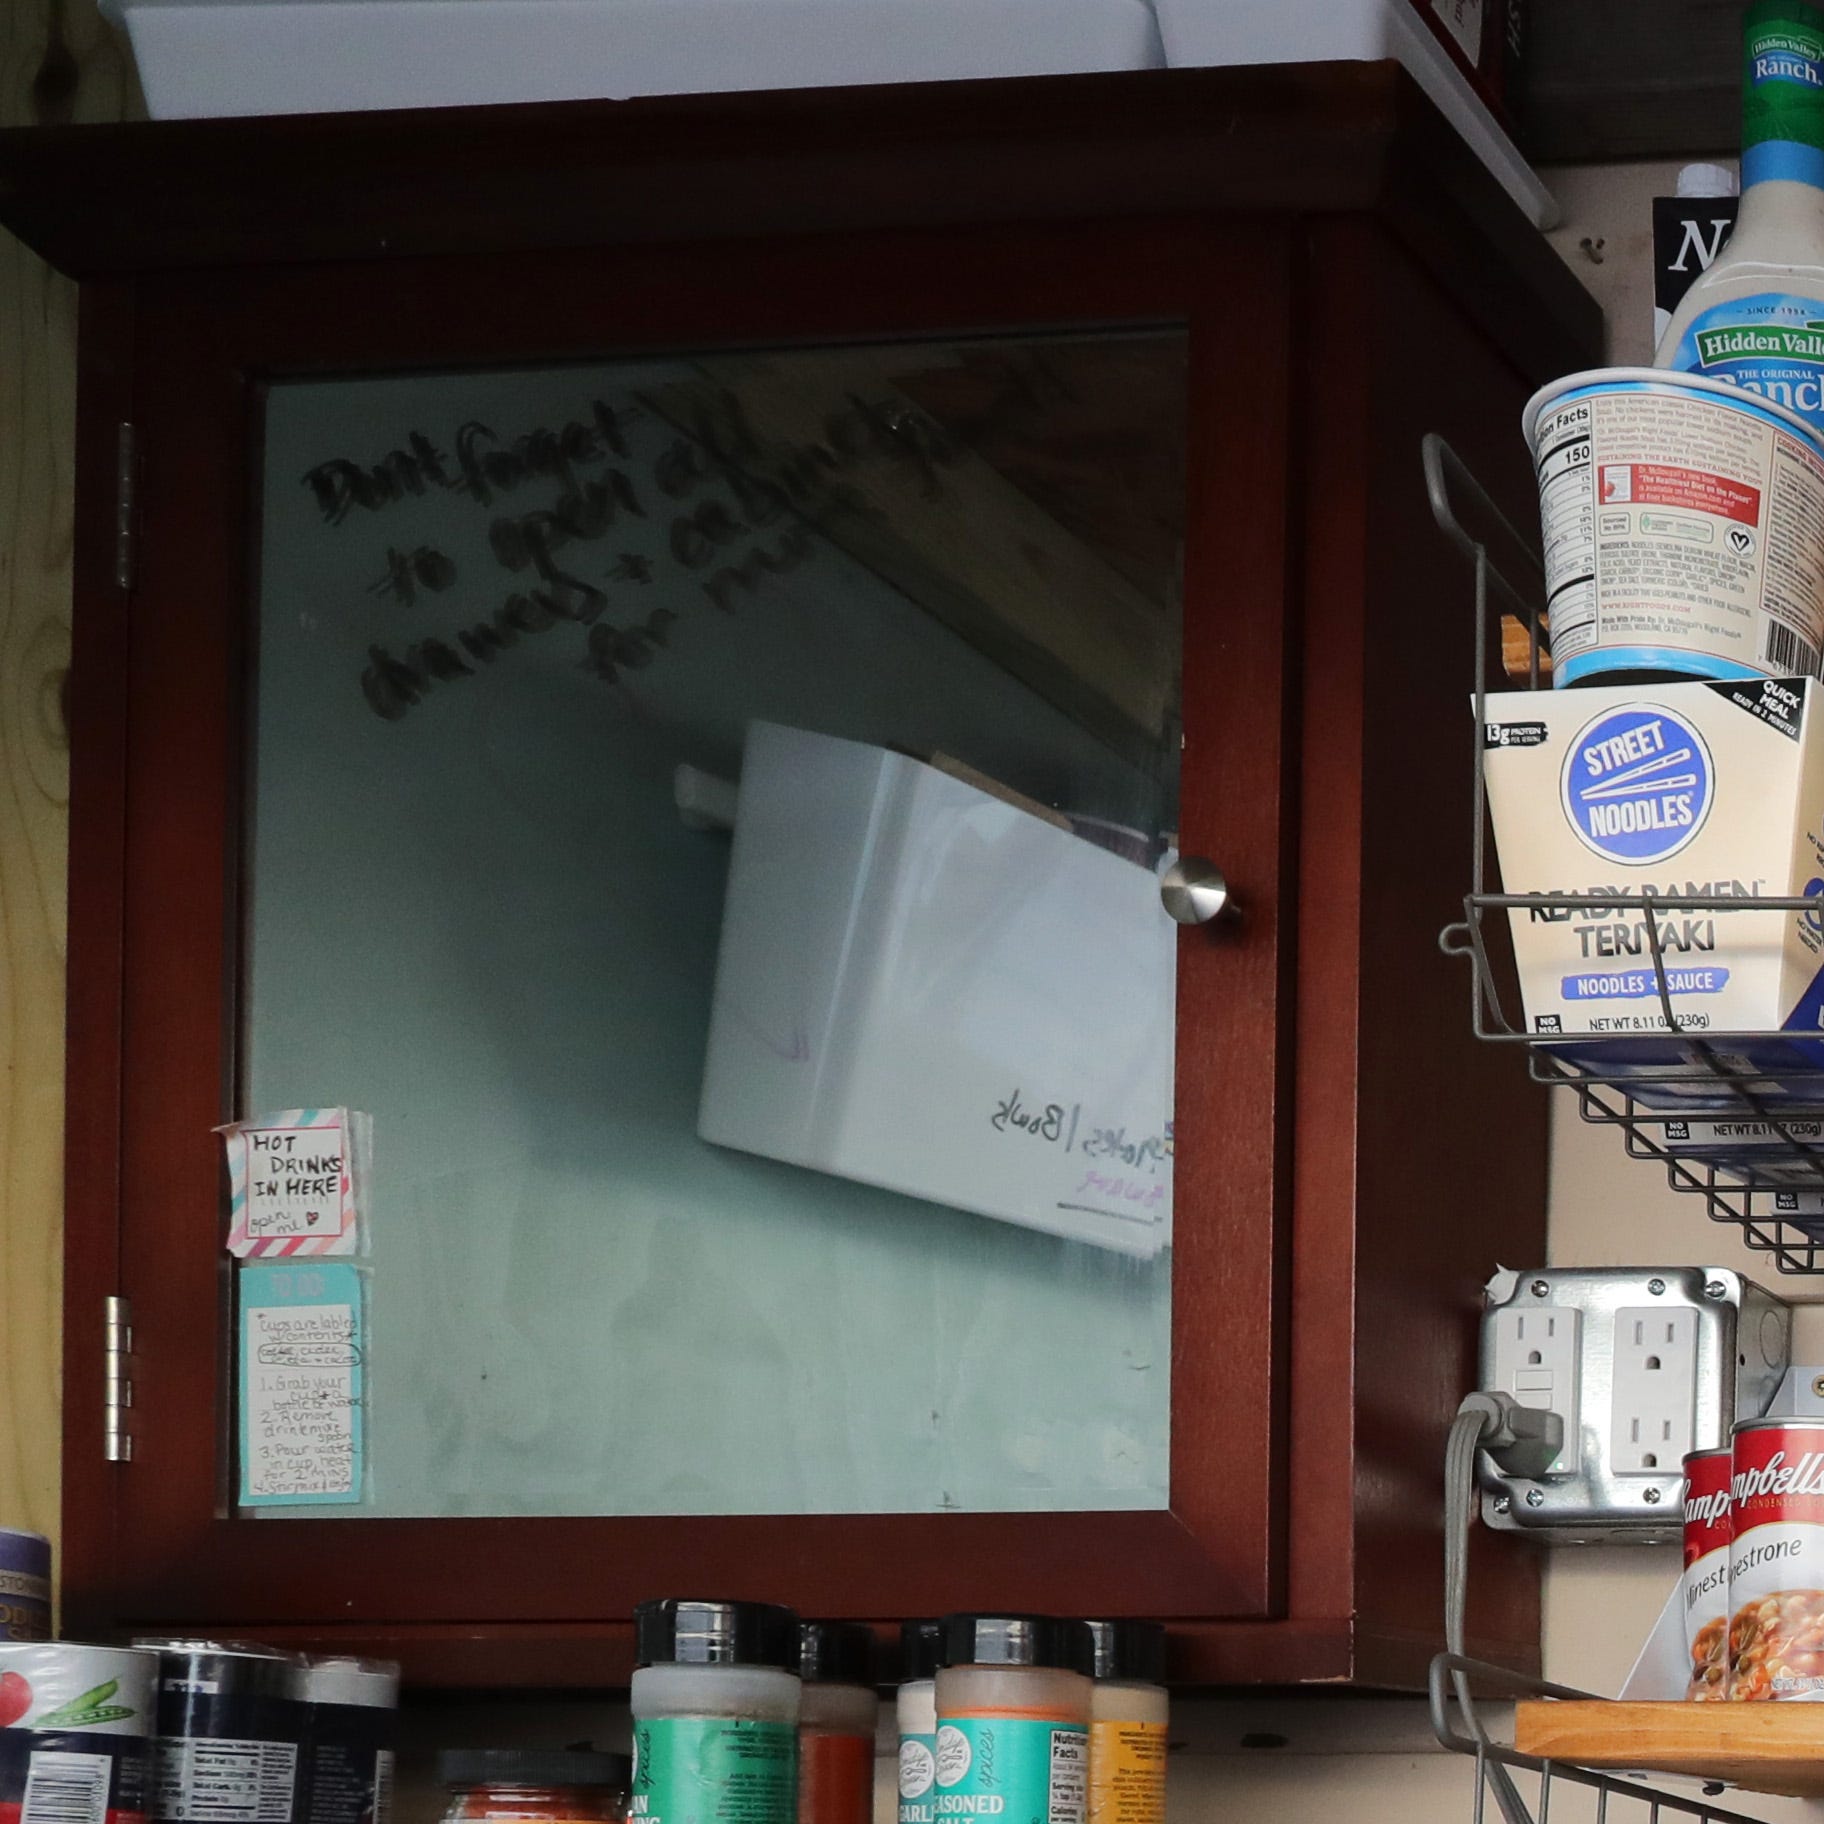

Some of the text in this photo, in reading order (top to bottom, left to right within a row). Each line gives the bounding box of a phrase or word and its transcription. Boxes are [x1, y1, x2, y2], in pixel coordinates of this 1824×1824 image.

[1704, 331, 1780, 357] Hidden
[1737, 369, 1815, 379] THE ORIGINAL
[1759, 694, 1788, 719] MEAL
[1763, 680, 1800, 708] QUICK
[1583, 720, 1666, 777] STREET
[1588, 795, 1694, 838] NOODLES
[253, 1135, 296, 1153] HOT
[270, 1156, 343, 1175] DRINKS
[255, 1176, 337, 1196] IN HERE
